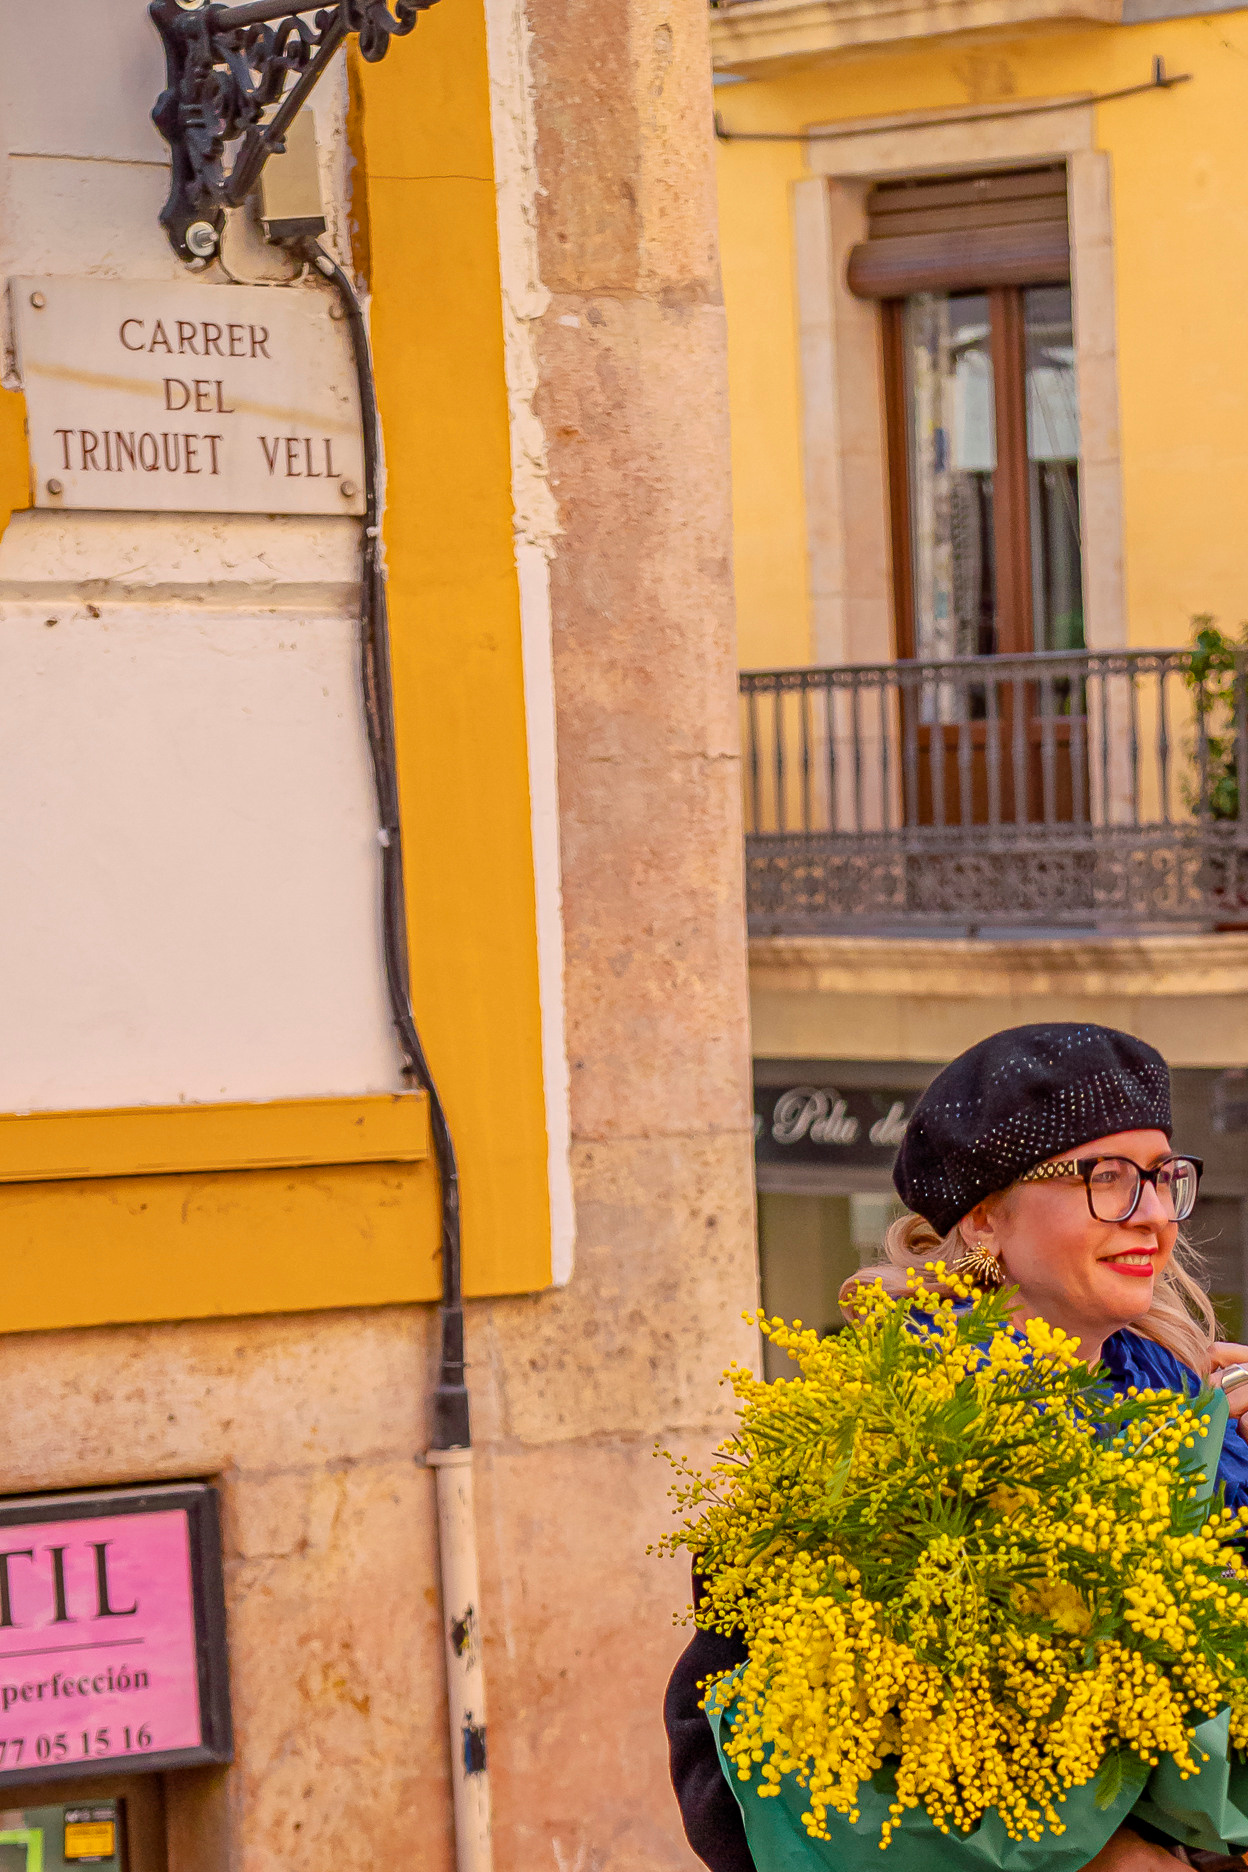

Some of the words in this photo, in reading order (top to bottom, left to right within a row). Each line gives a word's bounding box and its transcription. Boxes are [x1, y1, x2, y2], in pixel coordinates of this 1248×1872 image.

[119, 318, 272, 359] CARRER
[162, 378, 235, 414] DEL
[54, 429, 224, 475] TRINQUET
[257, 436, 343, 478] VELL
[2, 1663, 149, 1713] perfección
[35, 1731, 68, 1762] 05
[81, 1726, 111, 1755] 15
[123, 1721, 152, 1750] 16
